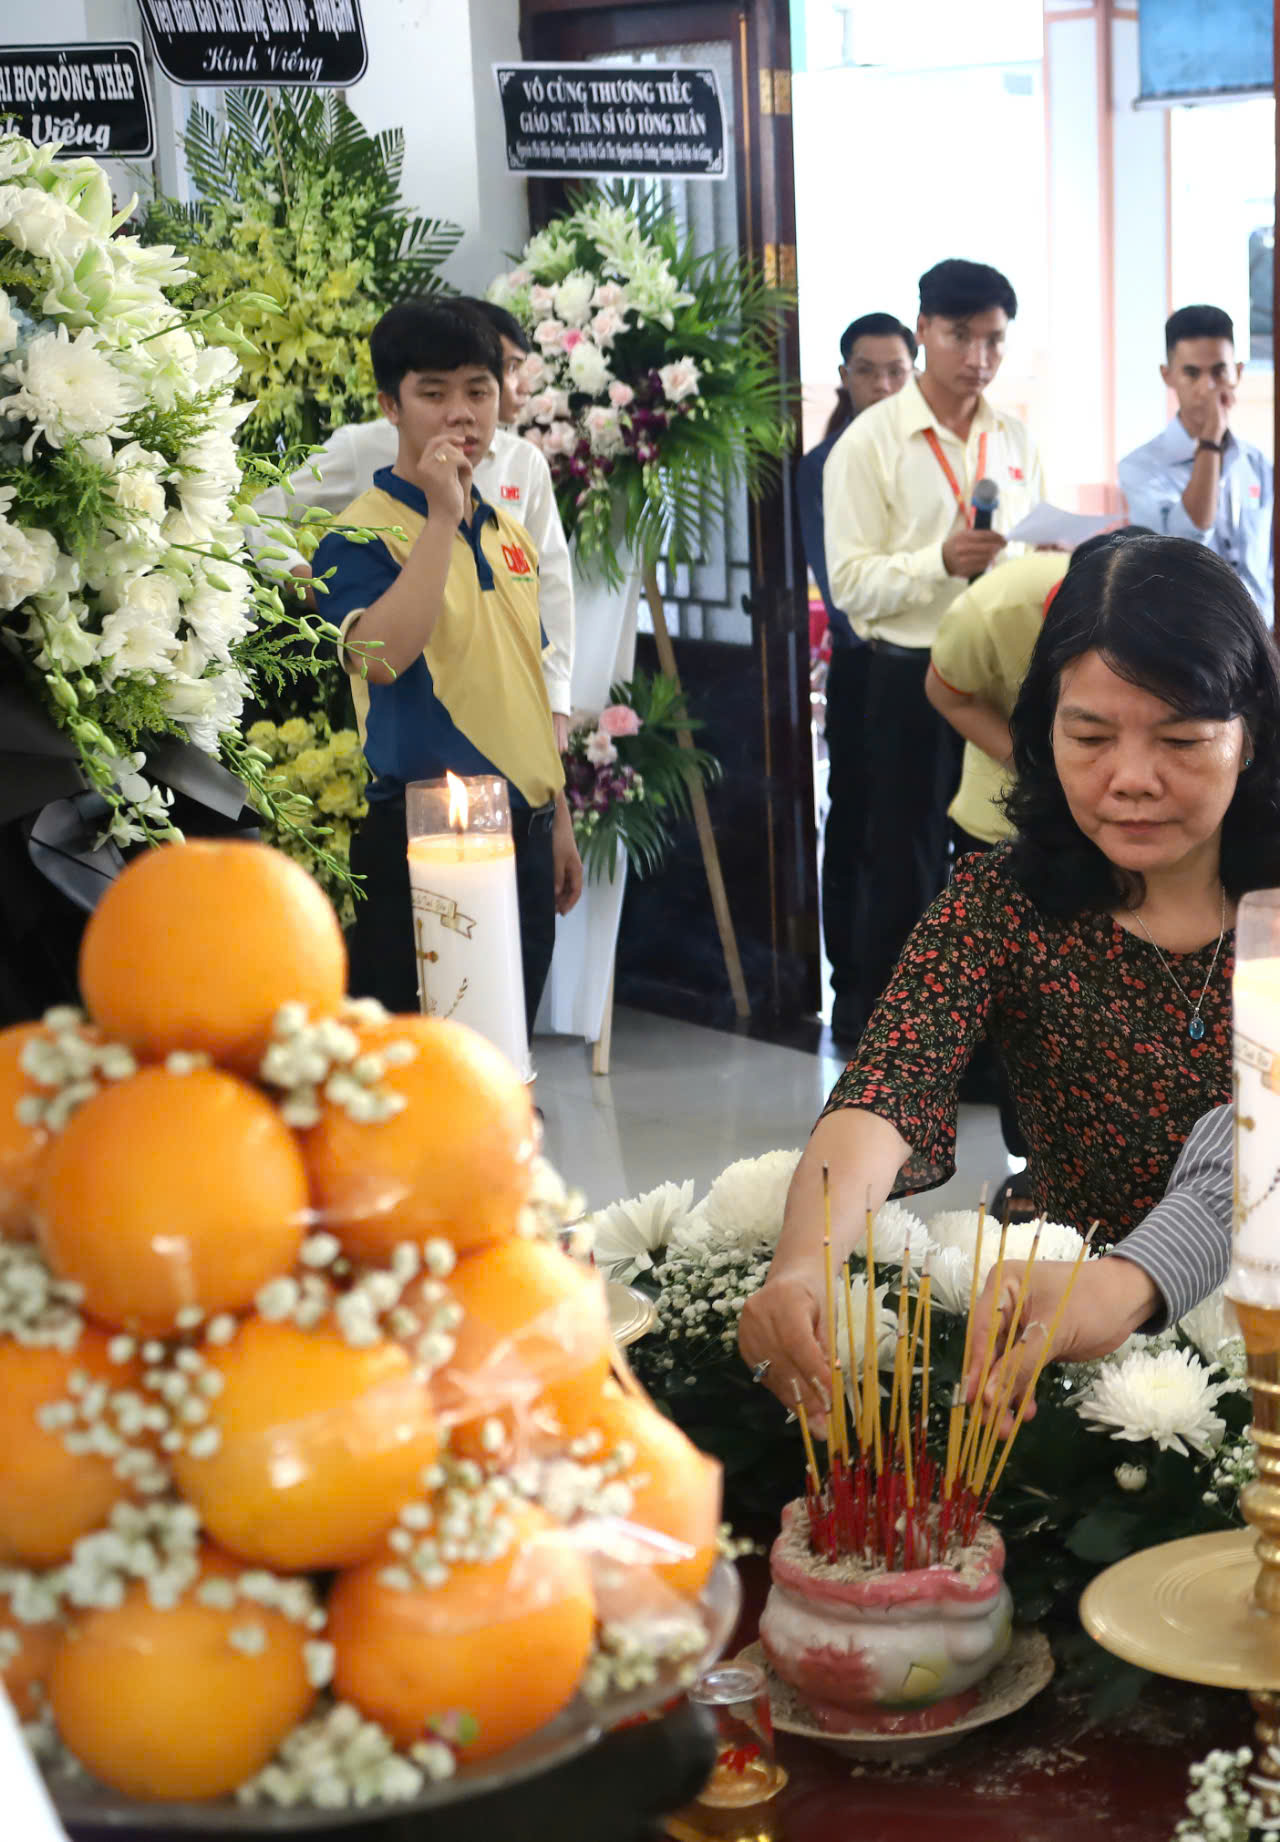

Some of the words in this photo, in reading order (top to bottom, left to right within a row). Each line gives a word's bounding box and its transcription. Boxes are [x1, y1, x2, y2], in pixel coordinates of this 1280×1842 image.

[0, 64, 13, 111] ẠI
[13, 64, 47, 111] HỌC
[47, 51, 95, 101] ĐỒNG
[92, 52, 135, 100] THÁP
[202, 44, 258, 72] Kính
[267, 46, 324, 82] Viếng
[588, 78, 655, 104] THƯƠNG
[31, 112, 111, 152] Viếng
[520, 105, 549, 133] GIÁO
[672, 108, 707, 136] XUÂN
